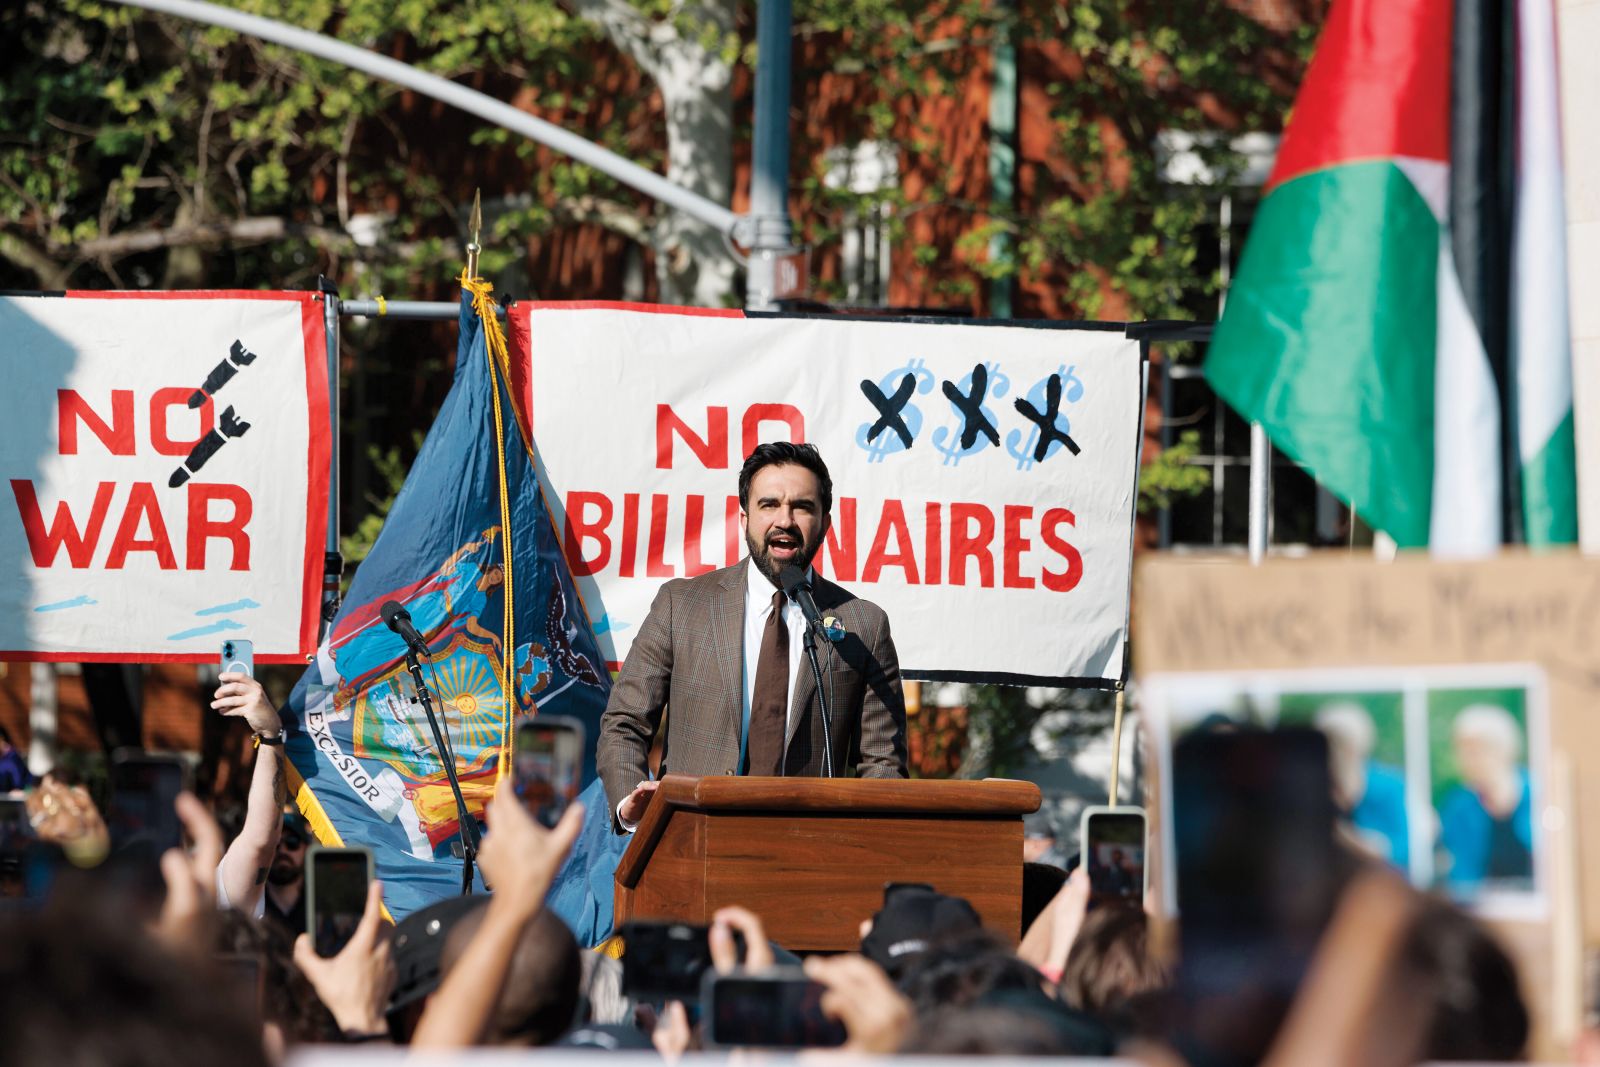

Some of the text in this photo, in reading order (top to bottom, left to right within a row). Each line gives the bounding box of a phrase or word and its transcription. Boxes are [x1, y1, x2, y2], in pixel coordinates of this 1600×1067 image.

[57, 387, 215, 457] NO
[655, 403, 805, 469] NO
[10, 478, 253, 571] WAR
[564, 490, 1083, 593] BILLINAIRES
